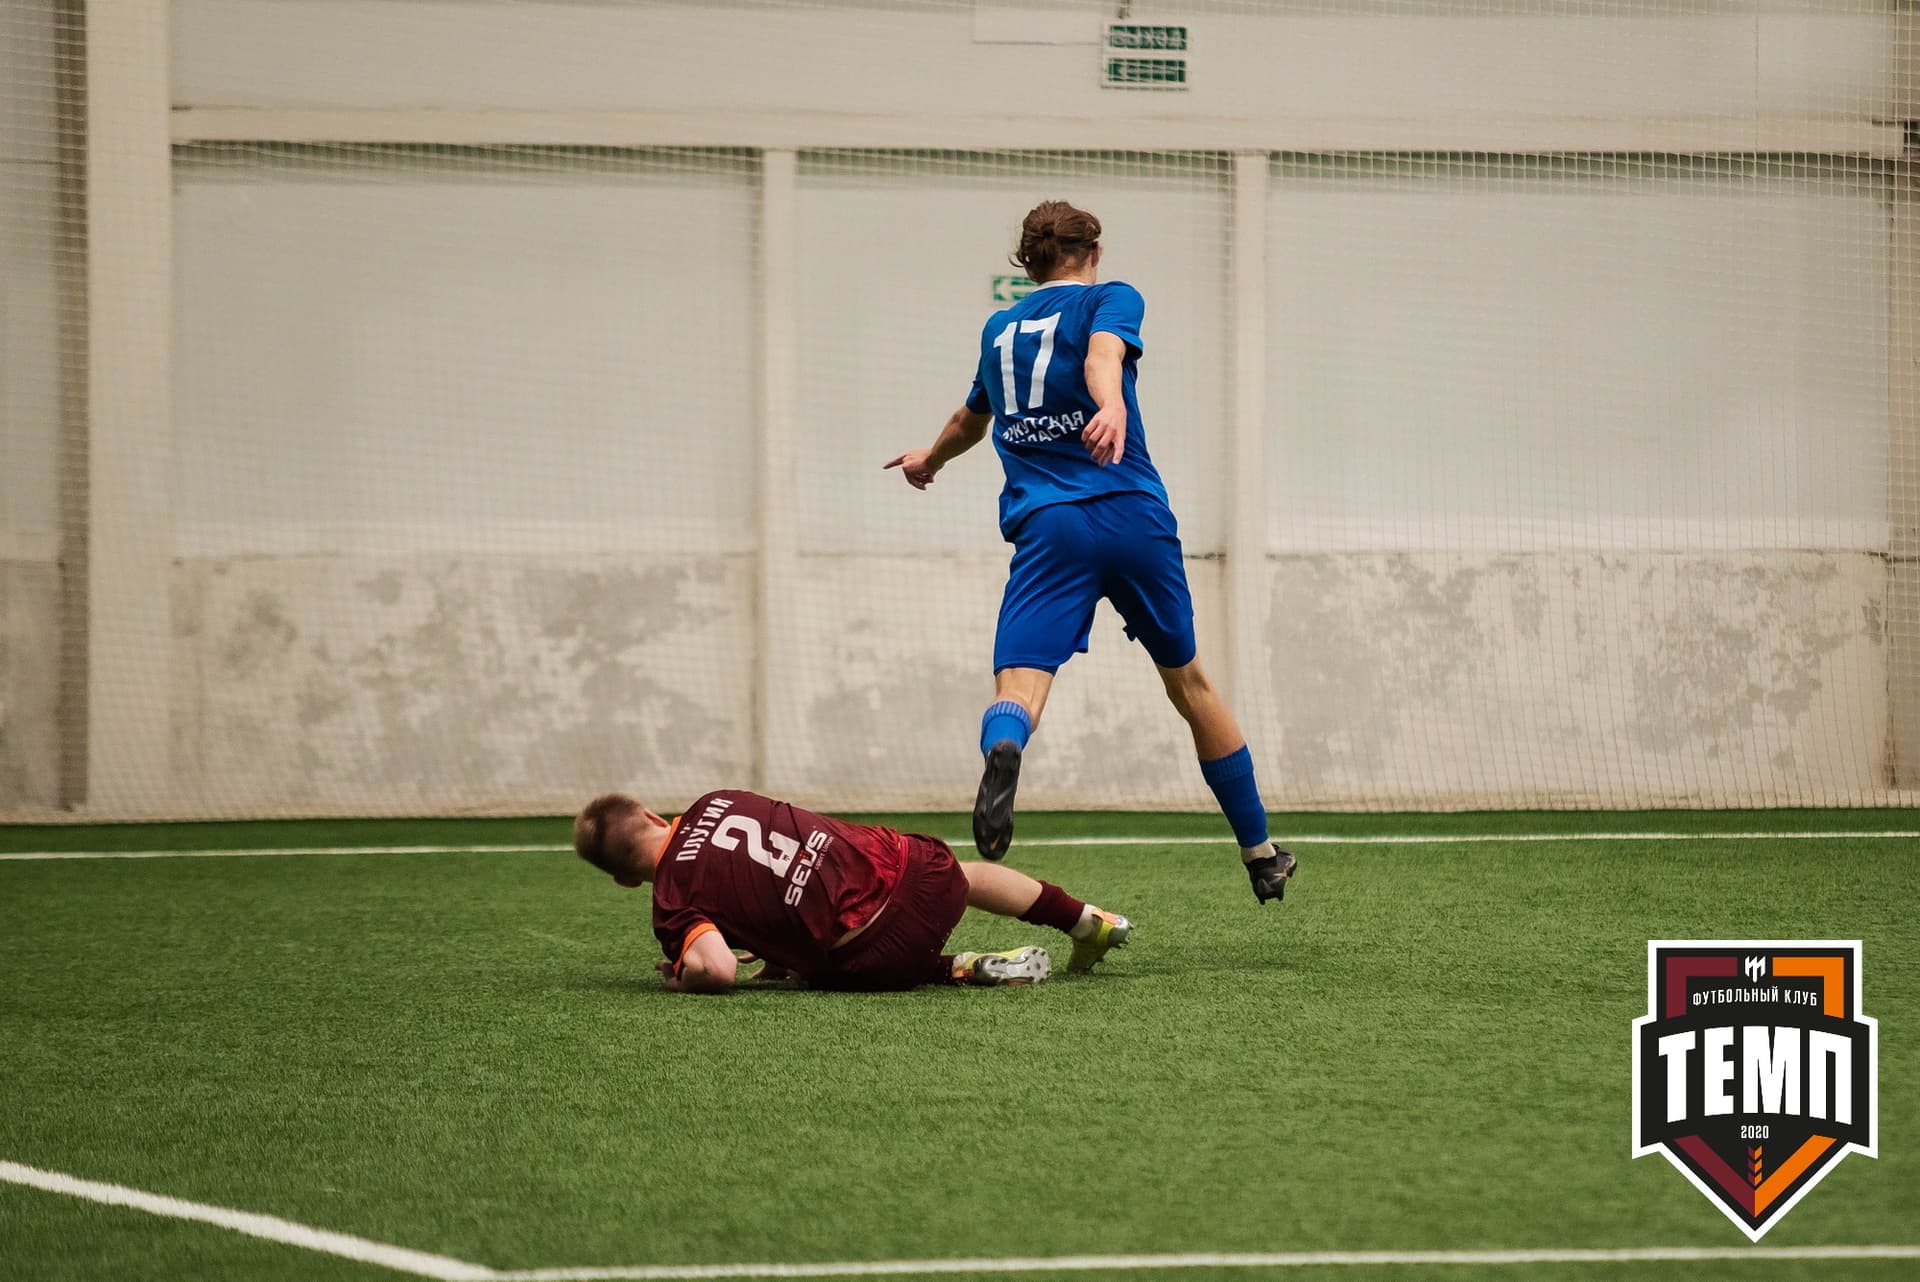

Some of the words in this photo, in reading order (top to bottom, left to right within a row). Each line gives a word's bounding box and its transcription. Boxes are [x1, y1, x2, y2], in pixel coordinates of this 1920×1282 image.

[993, 311, 1062, 416] 17
[675, 797, 735, 862] ПЛУГИН
[711, 814, 801, 878] 2
[784, 829, 828, 907] SEUS
